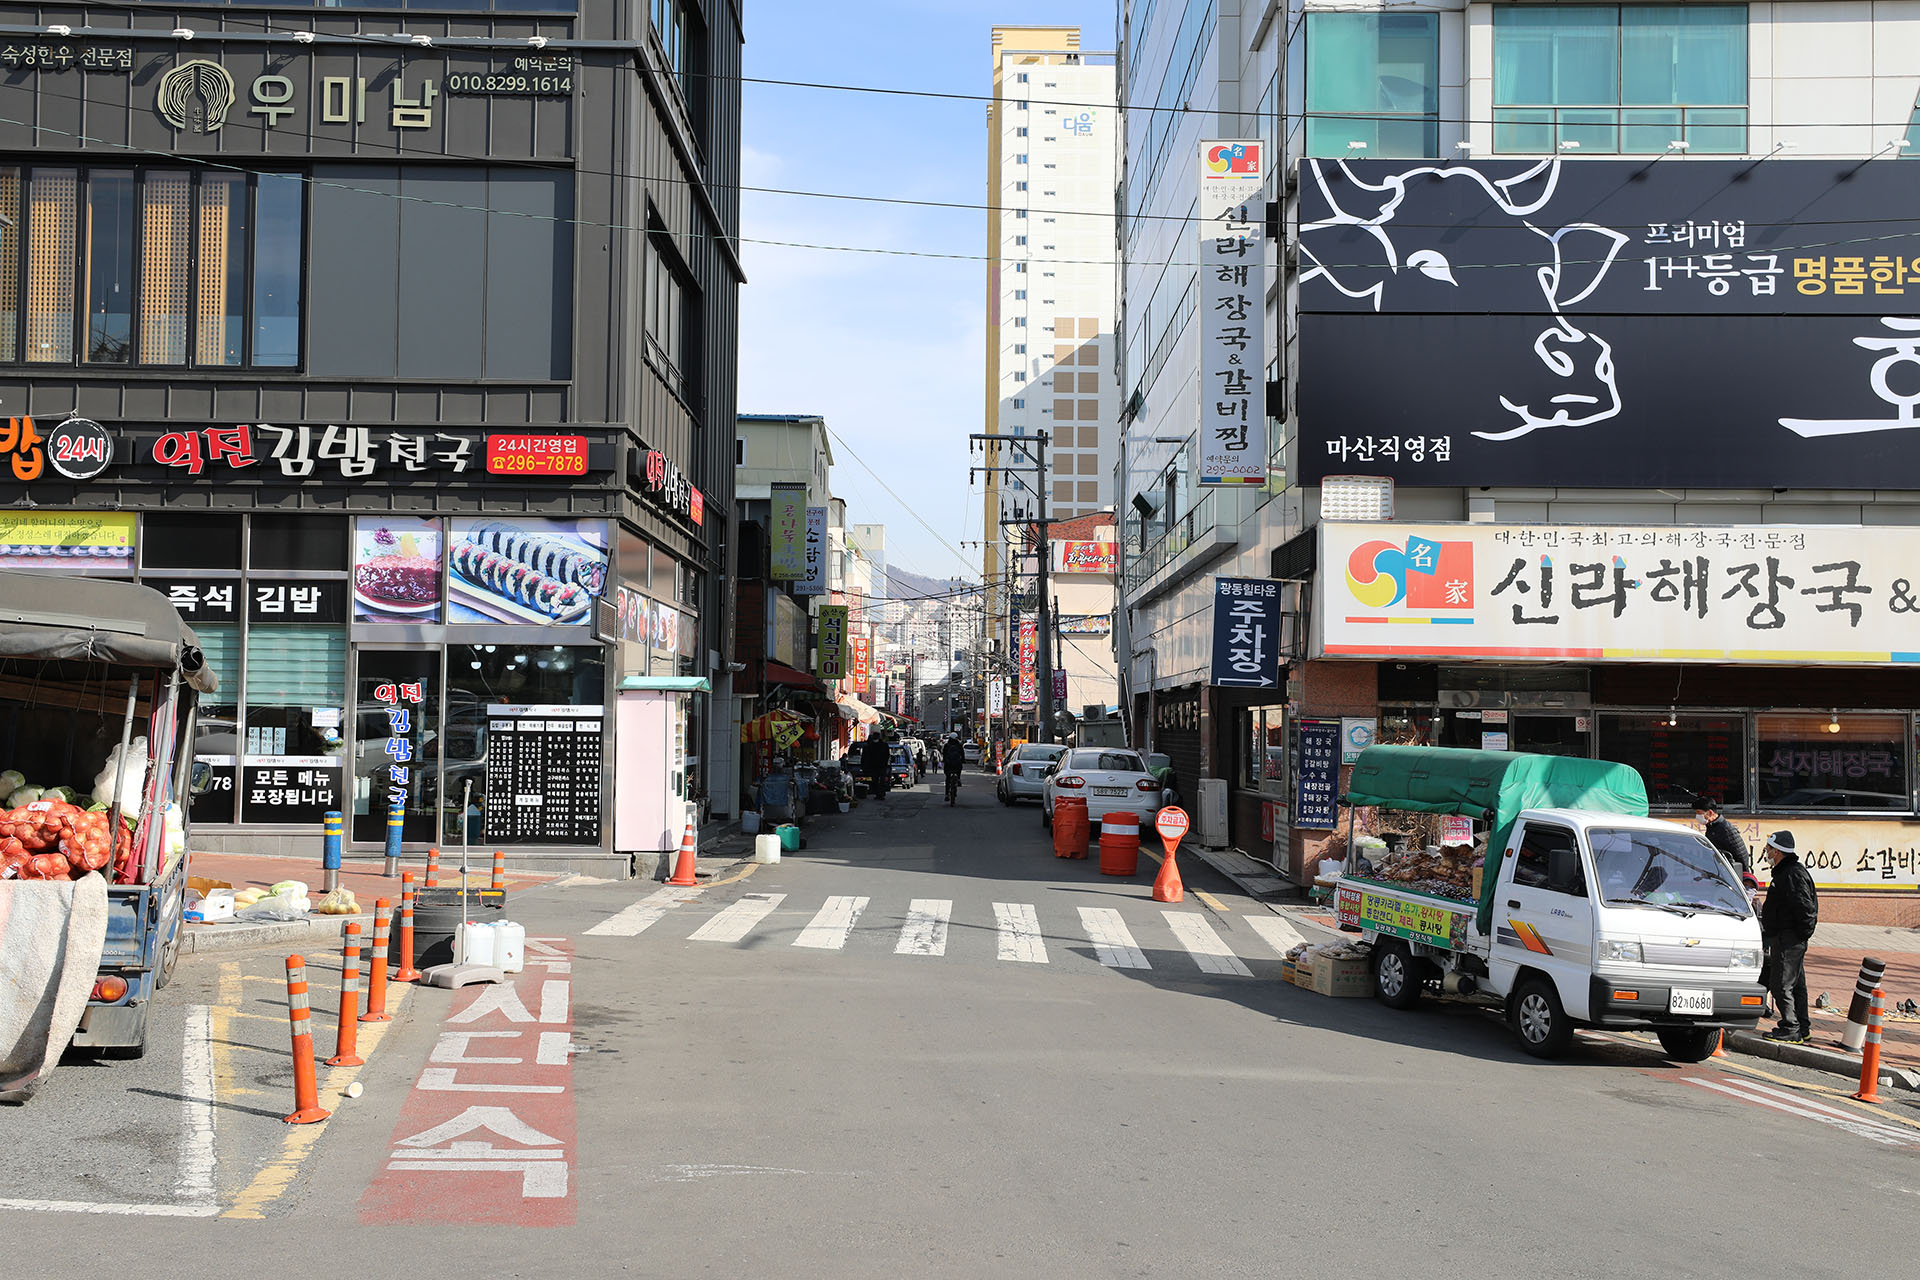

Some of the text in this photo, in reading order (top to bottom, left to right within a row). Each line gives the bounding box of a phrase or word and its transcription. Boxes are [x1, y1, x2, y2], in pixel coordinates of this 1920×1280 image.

[1, 45, 74, 66] 숙성한우
[450, 75, 572, 92] 010.8299.1614
[251, 75, 438, 128] 우미남
[1644, 220, 1747, 249] 프리미엄
[1215, 205, 1254, 350] 신라해장국
[1215, 368, 1253, 451] 갈비찜
[57, 434, 105, 462] 24시
[256, 424, 474, 477] 김밥천국
[497, 438, 578, 454] 24시간영업
[1326, 436, 1452, 463] 마산직영점
[507, 455, 584, 471] 296-7878
[1206, 465, 1261, 475] 299-0002
[167, 585, 321, 613] 즉석 김밥
[1491, 555, 1873, 630] 신라해장국
[1228, 600, 1267, 673] 주차장
[374, 682, 423, 704] 역전
[384, 707, 414, 805] 김밥천국
[1768, 750, 1895, 778] 선지해장국
[255, 769, 330, 786] 모든 메뉴
[250, 788, 334, 806] 포장됩니다
